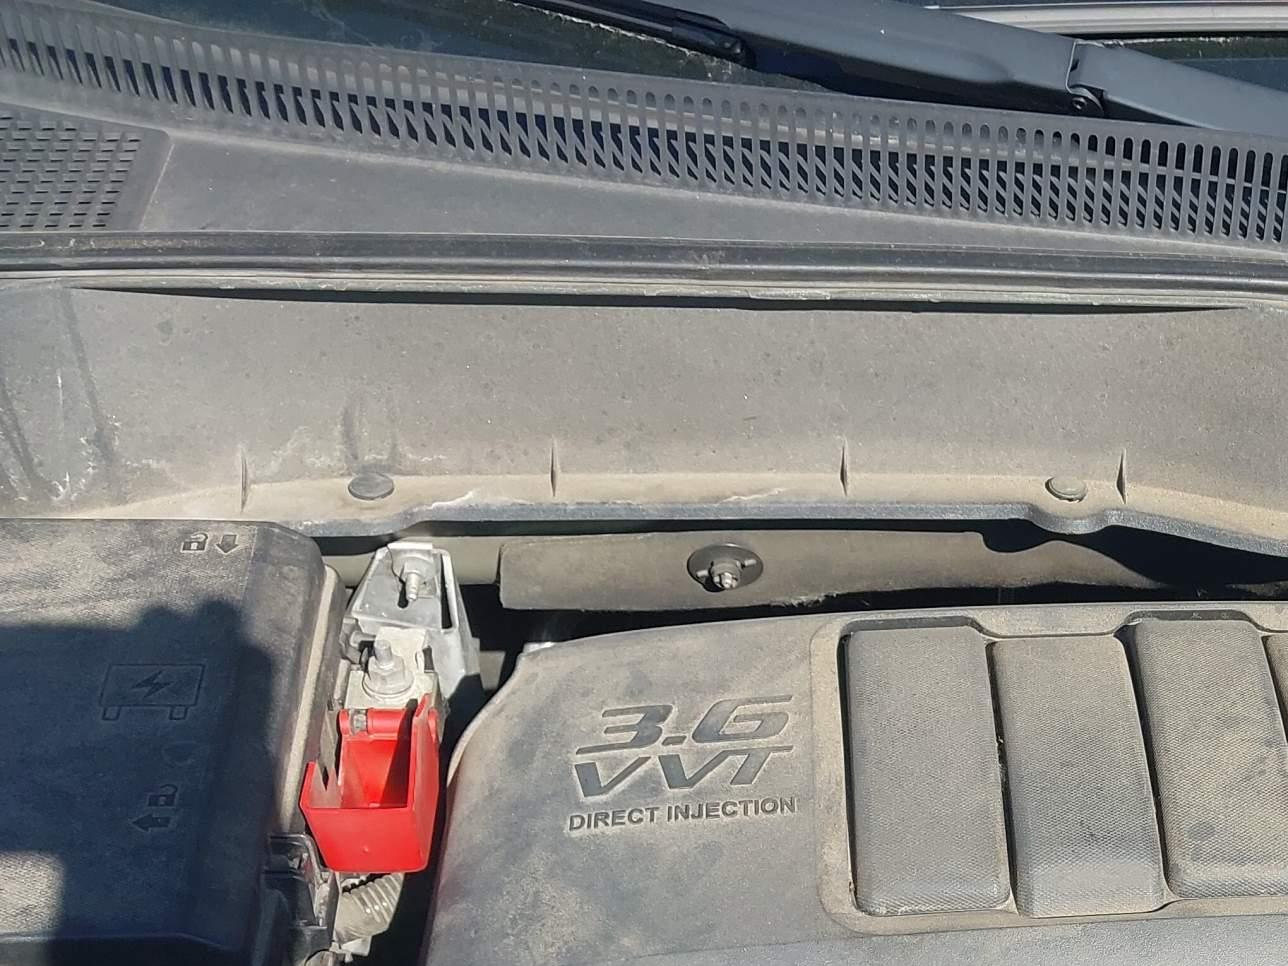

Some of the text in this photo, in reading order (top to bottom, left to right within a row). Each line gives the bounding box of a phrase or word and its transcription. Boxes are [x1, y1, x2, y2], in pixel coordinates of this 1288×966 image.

[576, 695, 793, 755] 3.6
[575, 745, 794, 798] VVT
[568, 797, 797, 832] DIRECT INJECTION
